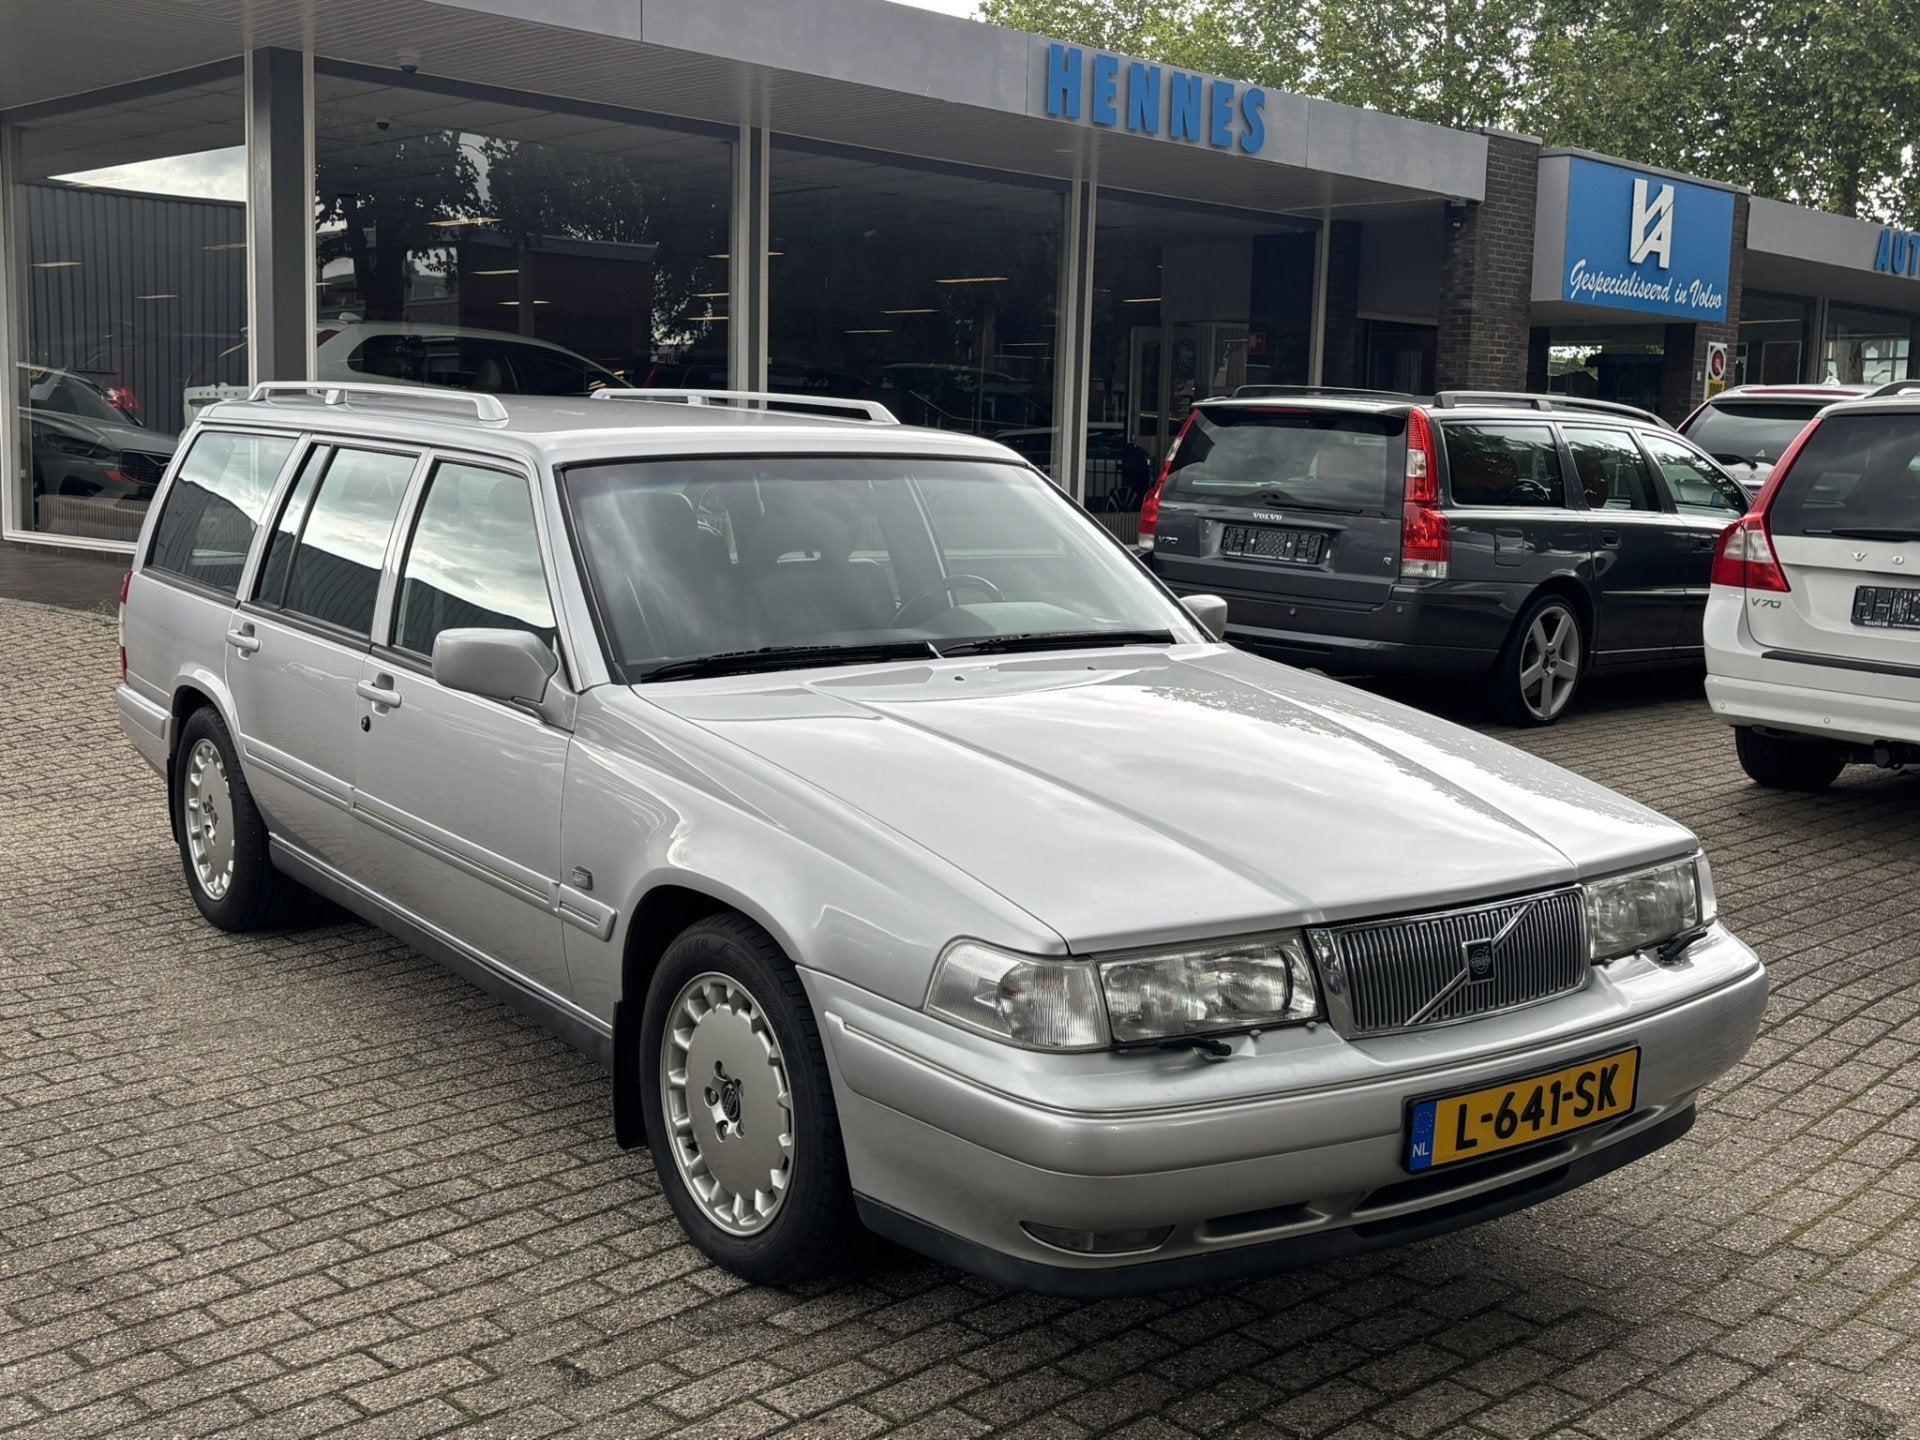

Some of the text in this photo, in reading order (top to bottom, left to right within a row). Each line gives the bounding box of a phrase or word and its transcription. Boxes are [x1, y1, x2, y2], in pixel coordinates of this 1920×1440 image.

[1048, 43, 1266, 154] HENNES
[1874, 228, 1920, 276] AUT
[1570, 259, 1722, 309] Gespecialiseerd in Volvo
[1252, 512, 1283, 521] VOLVO
[1751, 597, 1782, 609] V70
[1412, 1063, 1620, 1158] NL L-641-SK
